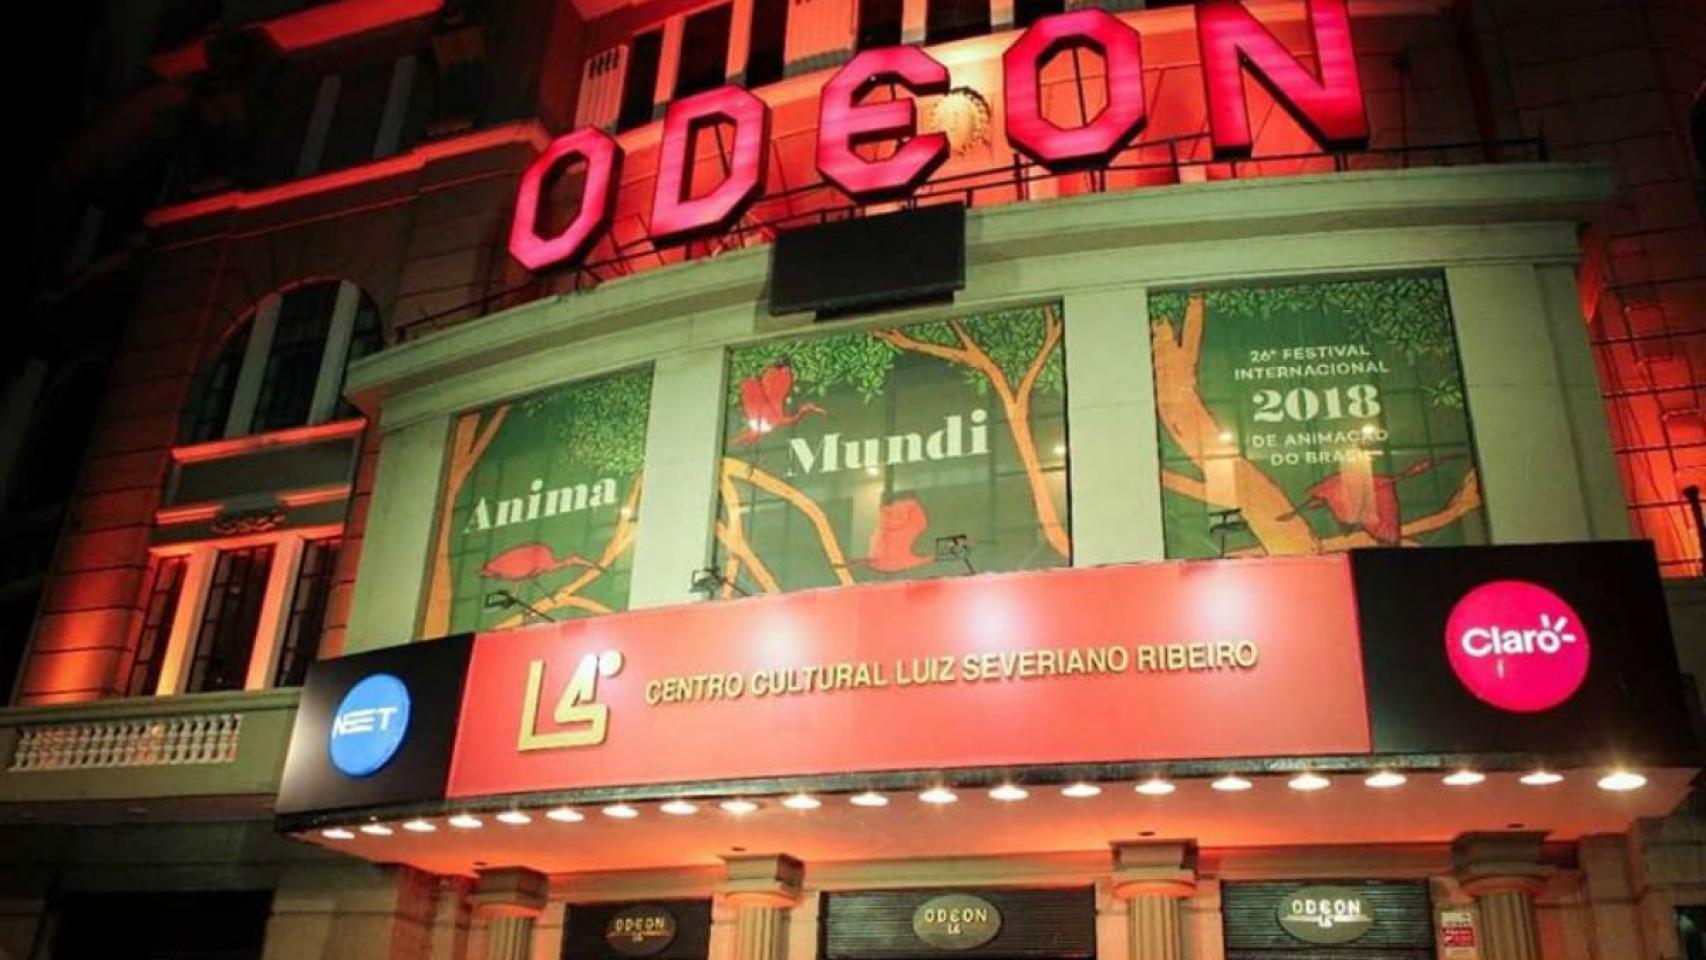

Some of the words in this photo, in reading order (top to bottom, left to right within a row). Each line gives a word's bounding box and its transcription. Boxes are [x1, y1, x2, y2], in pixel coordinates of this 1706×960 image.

[508, 0, 1370, 272] ODEON
[1282, 343, 1371, 361] FESTIVAL
[1234, 360, 1391, 381] INTERNACIONAL
[1252, 383, 1381, 422] 2018
[783, 408, 992, 478] Mundi
[1252, 434, 1279, 448] DE
[1270, 452, 1299, 466] DO
[463, 475, 618, 534] Anima
[1461, 614, 1572, 657] Claro
[645, 671, 744, 705] CENTRO
[750, 663, 888, 697] CULTURAL
[896, 656, 956, 687] LUIZ
[961, 646, 1129, 682] SEVERIANO
[1137, 640, 1259, 672] RIBEIRO
[332, 707, 398, 738] NET
[925, 907, 989, 923] ODEON
[1291, 898, 1361, 915] ODEON
